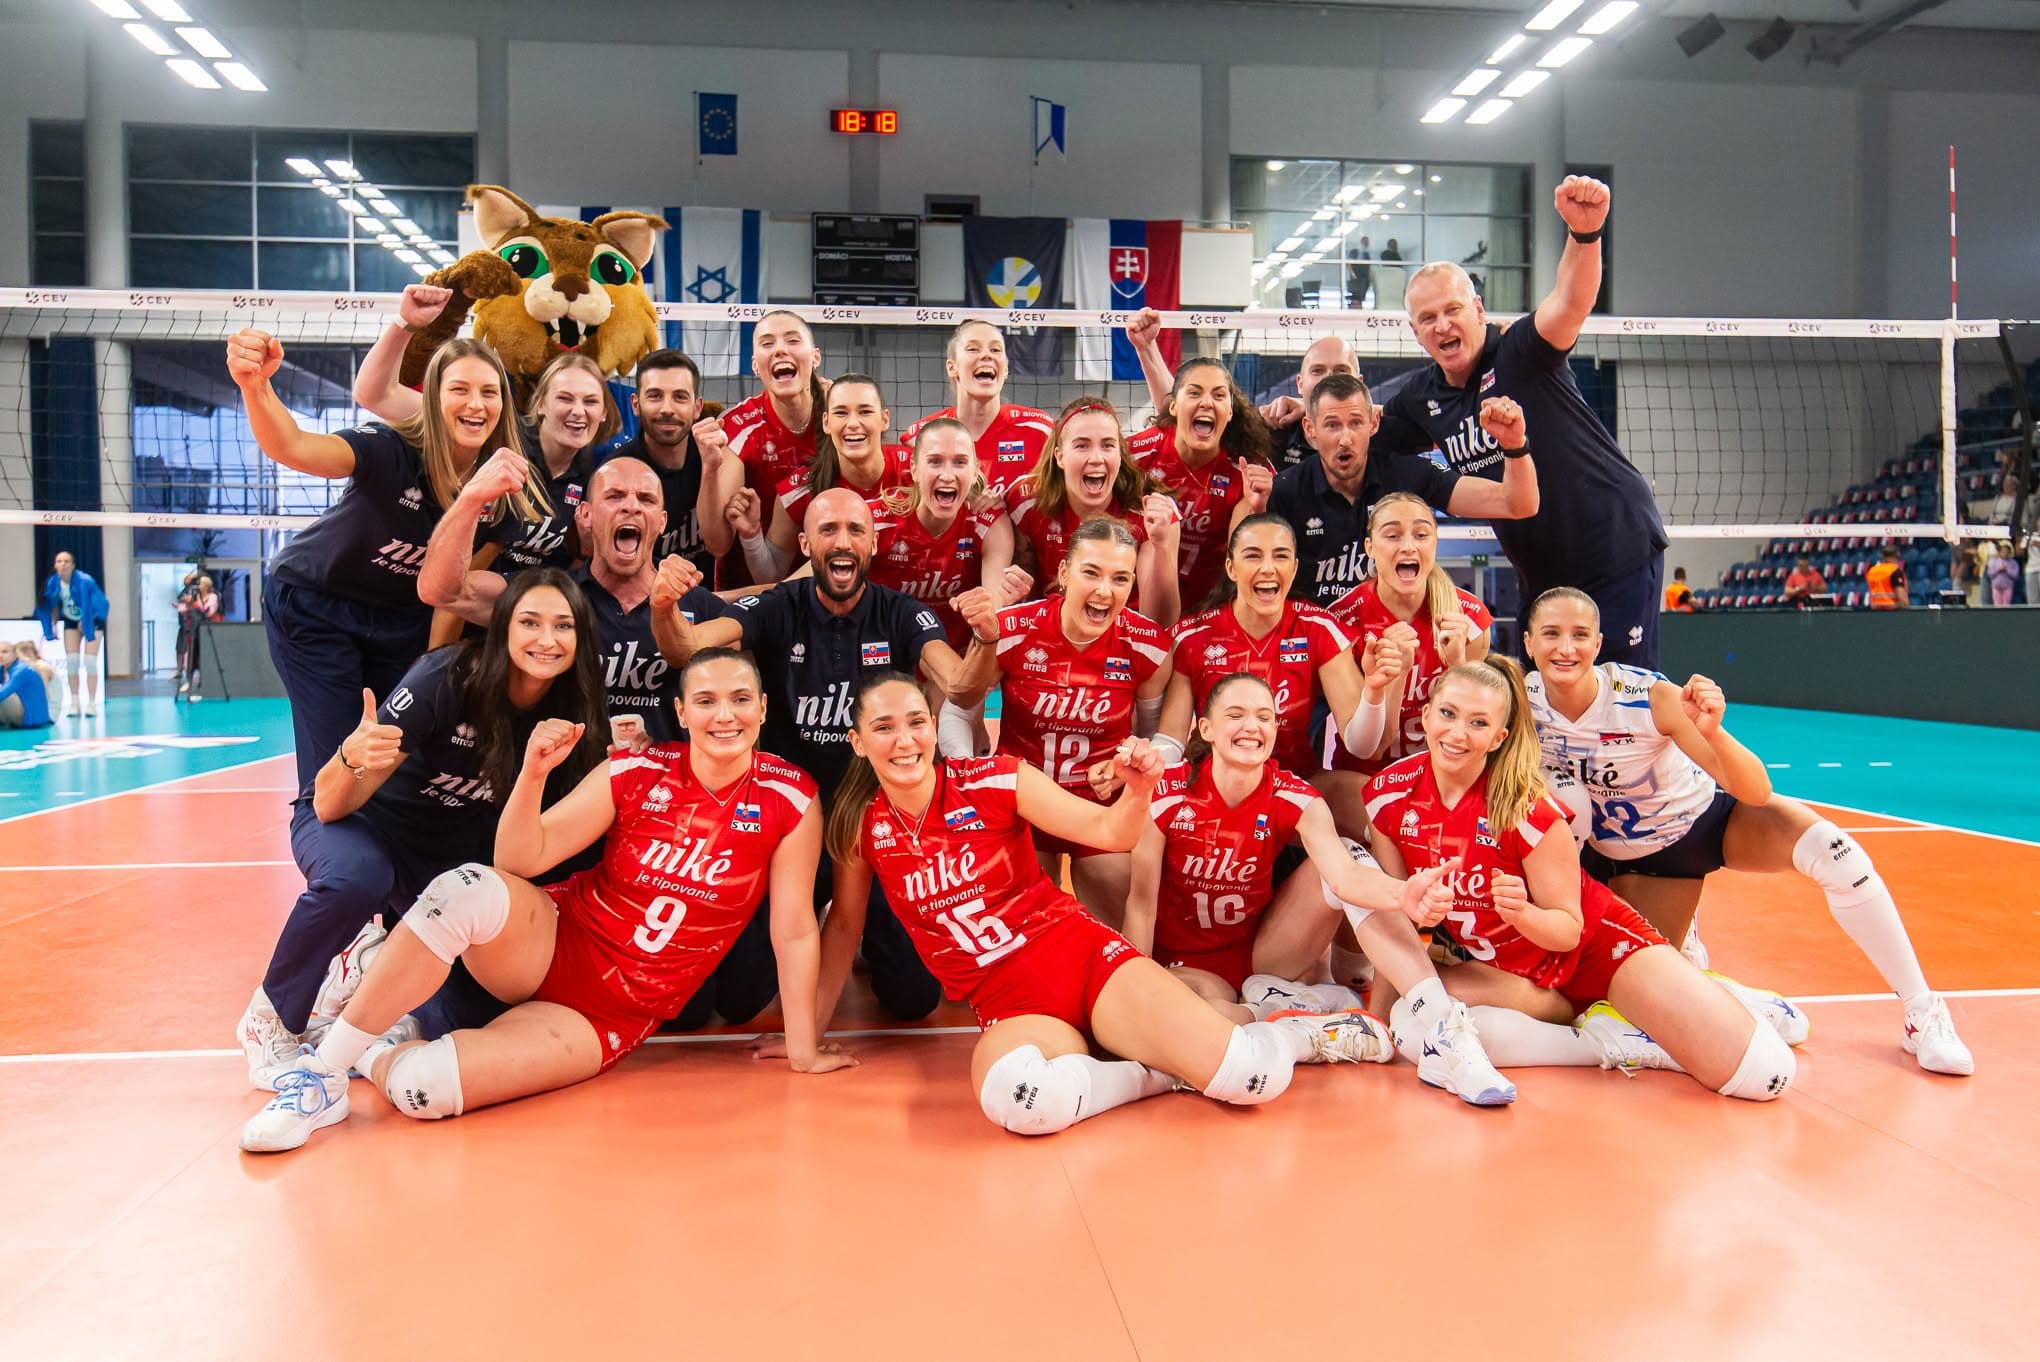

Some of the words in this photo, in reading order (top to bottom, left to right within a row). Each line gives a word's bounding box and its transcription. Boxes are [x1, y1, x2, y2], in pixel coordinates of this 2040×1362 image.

[838, 110, 896, 133] 18:18
[42, 292, 67, 302] CEV
[147, 295, 171, 305] CEV
[250, 297, 274, 307] CEV
[351, 299, 374, 309] CEV
[655, 306, 670, 316] EV
[743, 308, 766, 317] CEV
[838, 309, 861, 318] CEV
[931, 311, 954, 320] CEV
[1024, 312, 1046, 321] CEV
[1114, 314, 1128, 323] CE
[1205, 315, 1226, 324] CEV
[1293, 317, 1315, 326] CEV
[1381, 318, 1402, 328] CEV
[1636, 321, 1656, 330] CEV
[1719, 322, 1739, 331] CEV
[1801, 323, 1821, 332] CEV
[1881, 324, 1902, 333] CEV
[1962, 324, 1982, 333] CEV
[399, 497, 420, 512] errea
[661, 508, 704, 557] nik
[1306, 528, 1324, 536] errea
[1317, 583, 1330, 598] je
[863, 656, 890, 665] SVK
[1280, 653, 1309, 663] SVK
[599, 640, 668, 690] iké
[1023, 662, 1047, 673] errea
[1104, 672, 1131, 681] SVK
[795, 680, 855, 728] nik
[1032, 686, 1111, 724] niké
[1033, 719, 1047, 729] je
[451, 735, 476, 748] errea
[1040, 732, 1090, 785] 12
[759, 762, 802, 781] Slovnaft
[958, 761, 995, 777] Slovnaft
[1557, 780, 1575, 789] errea
[641, 800, 669, 813] errea
[731, 820, 760, 833] SVK
[1169, 821, 1195, 831] errea
[1254, 829, 1271, 839] SK
[1400, 826, 1418, 838] rrea
[873, 836, 897, 850] errea
[1833, 847, 1852, 861] errea
[639, 837, 733, 887] niké
[1182, 847, 1258, 883] niké
[903, 843, 980, 902] niké
[635, 870, 650, 884] je
[651, 877, 719, 902] tipovanie
[918, 903, 928, 916] je
[929, 883, 986, 911] tipovanie
[1450, 896, 1489, 909] ovanie
[633, 895, 687, 954] 9
[935, 897, 1013, 956] 15
[1256, 1074, 1268, 1096] errea
[405, 1088, 420, 1111] errea
[1025, 1086, 1040, 1110] errea
